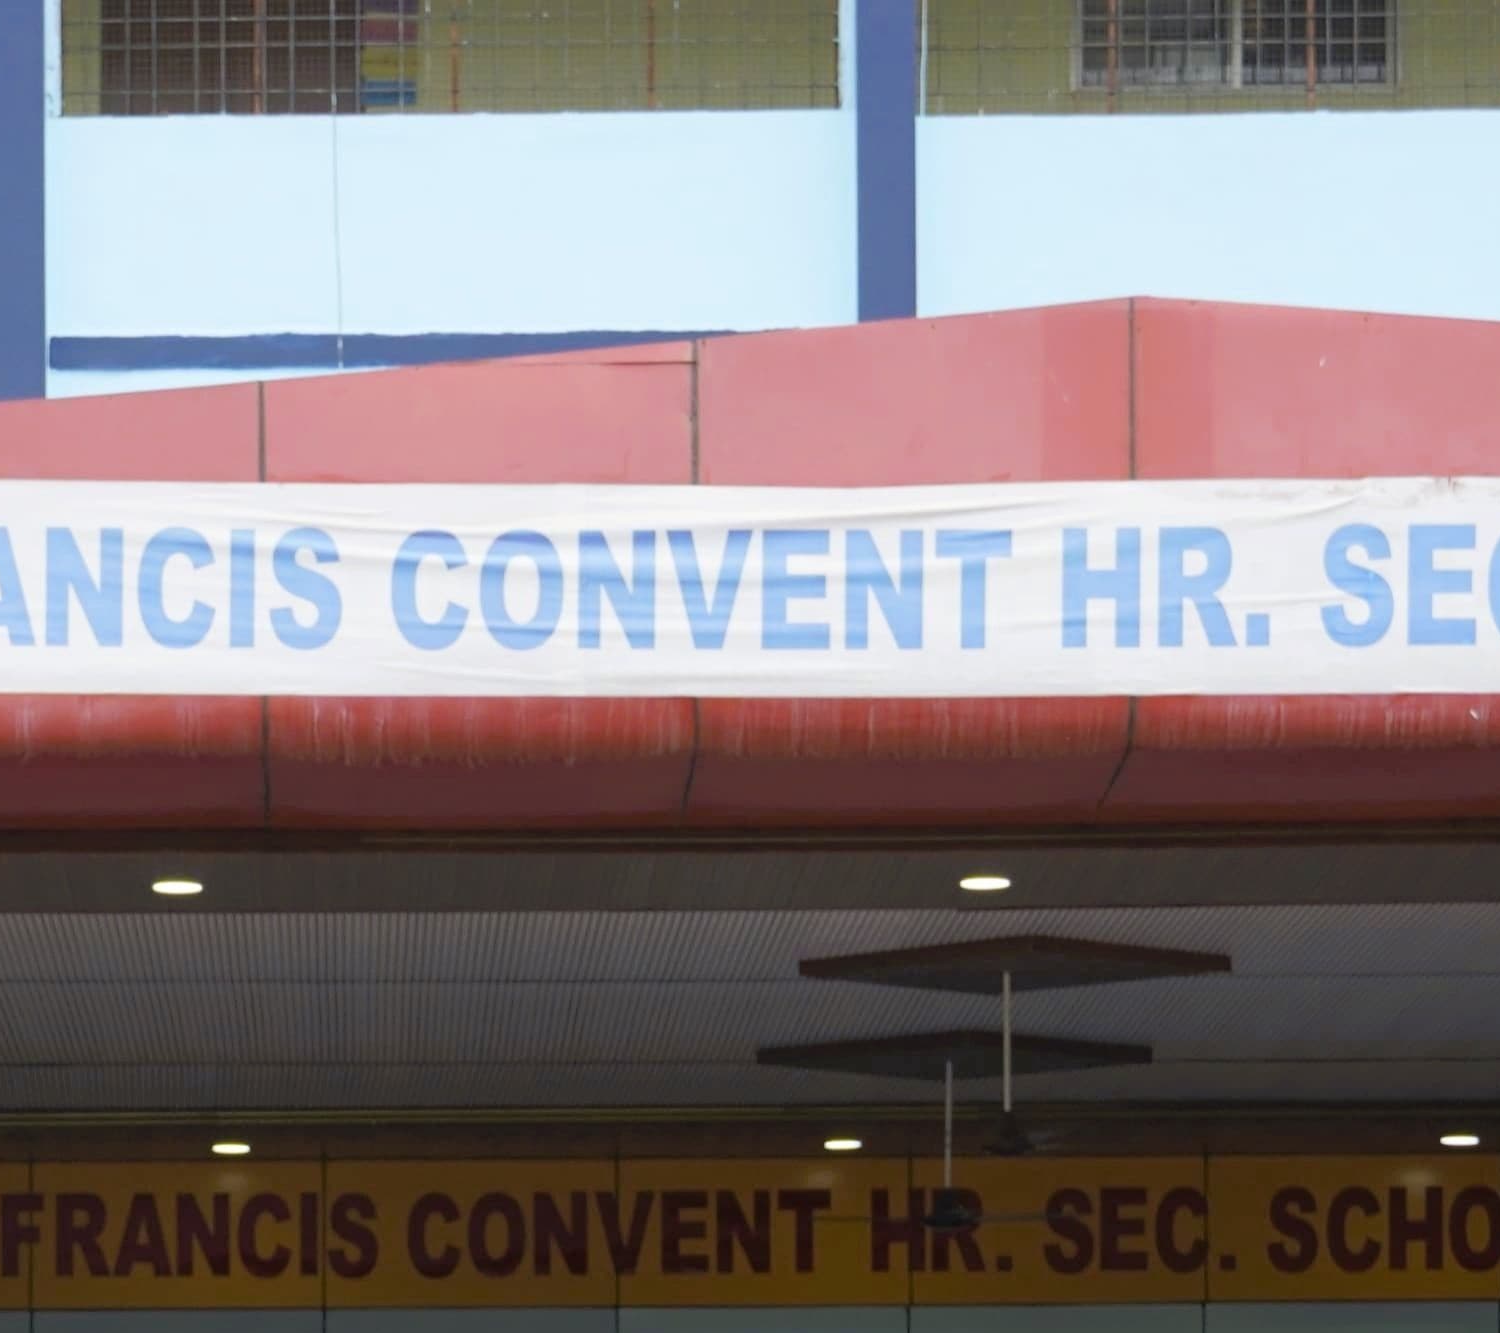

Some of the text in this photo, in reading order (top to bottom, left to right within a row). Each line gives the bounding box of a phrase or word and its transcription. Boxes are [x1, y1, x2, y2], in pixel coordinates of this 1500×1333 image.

[391, 529, 1012, 652] CONVENT
[1062, 527, 1270, 648] HR.
[0, 1191, 377, 1277] FRANCIS
[408, 1189, 829, 1275] CONVENT
[871, 1188, 1012, 1272] HR.
[1044, 1187, 1235, 1273] SEC.
